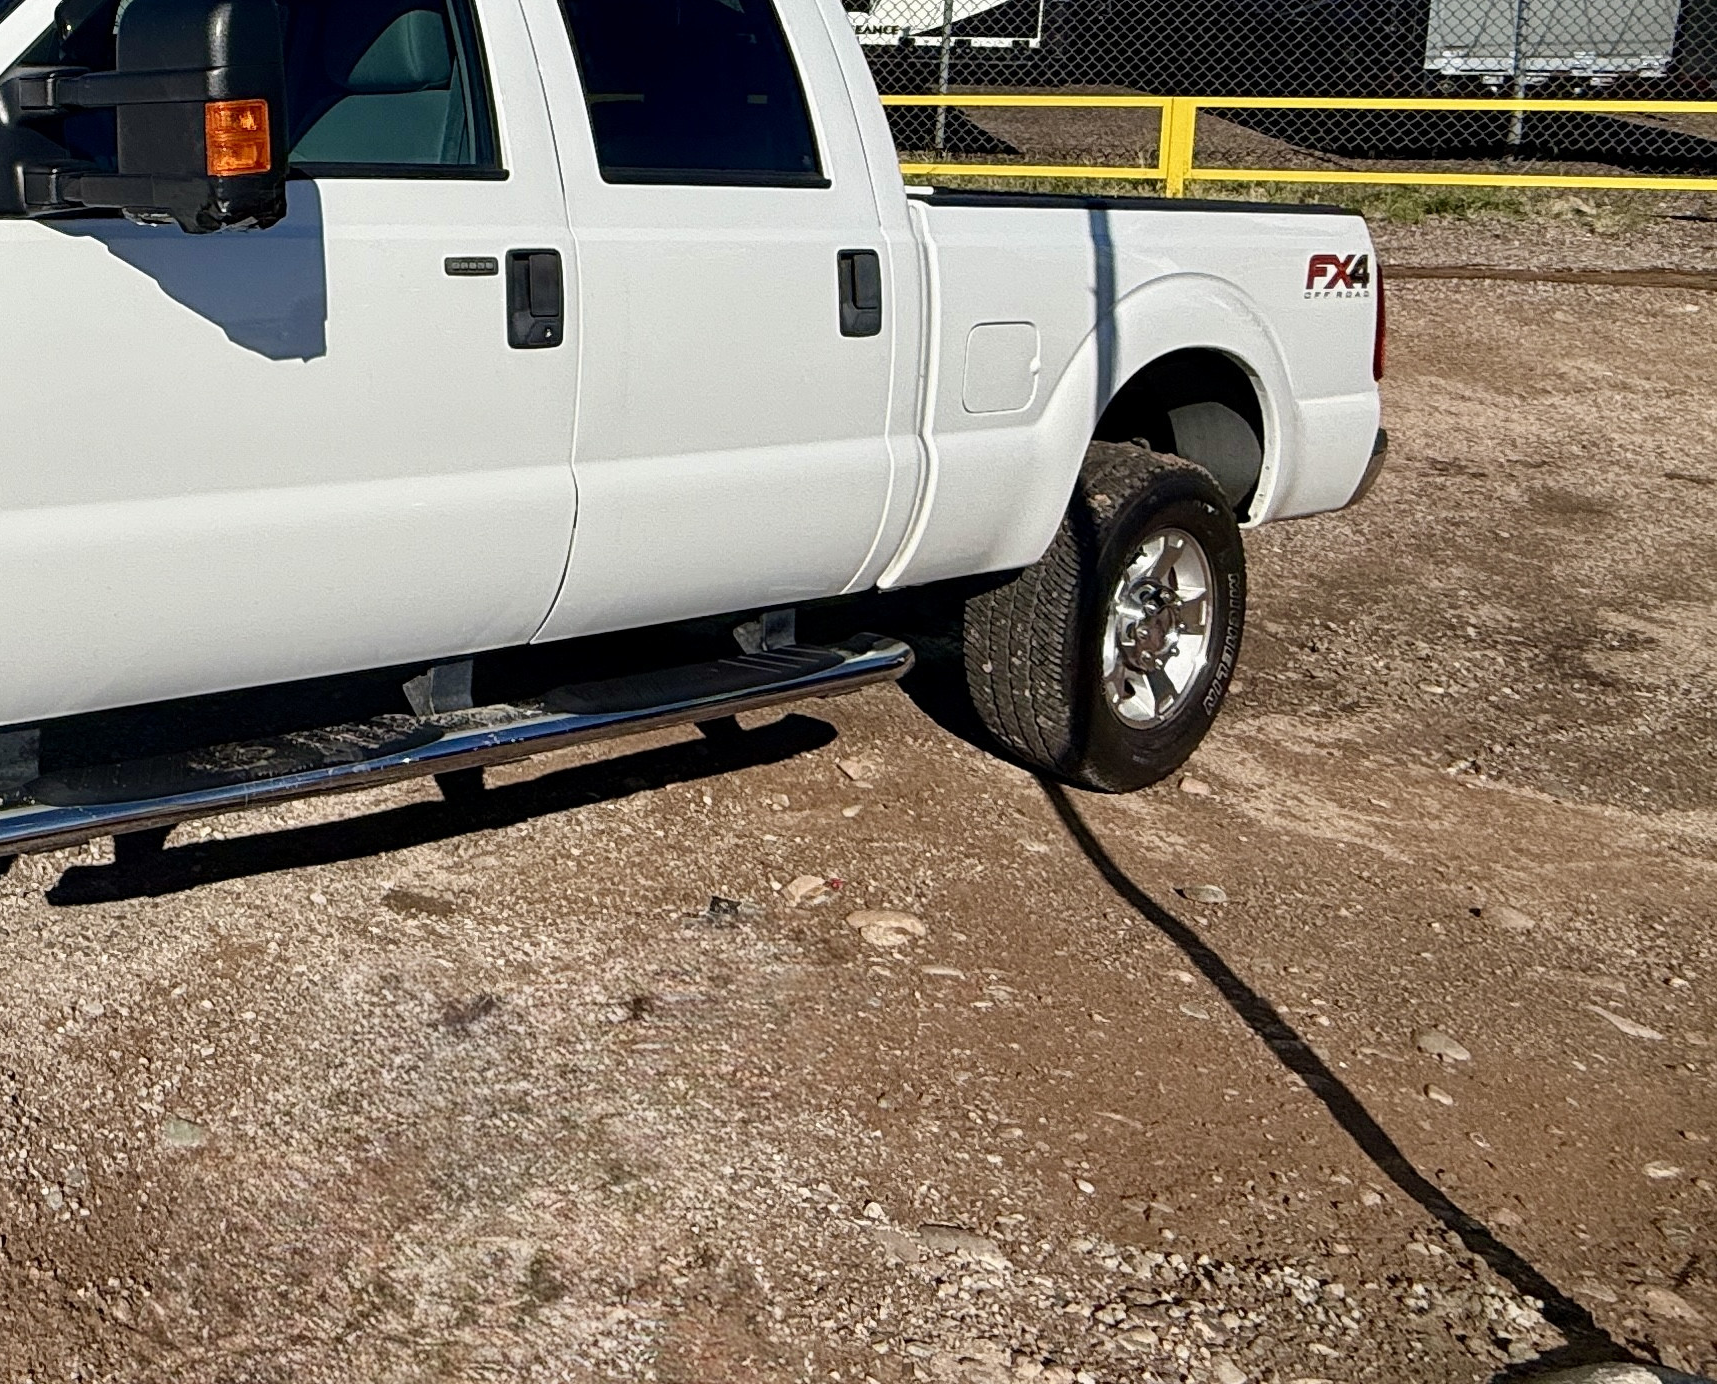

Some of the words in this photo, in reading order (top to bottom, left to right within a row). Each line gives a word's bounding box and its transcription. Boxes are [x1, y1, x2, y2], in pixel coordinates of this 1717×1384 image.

[853, 25, 900, 35] EANCE
[1306, 254, 1370, 289] FX4
[1202, 573, 1241, 716] MICHELIN
